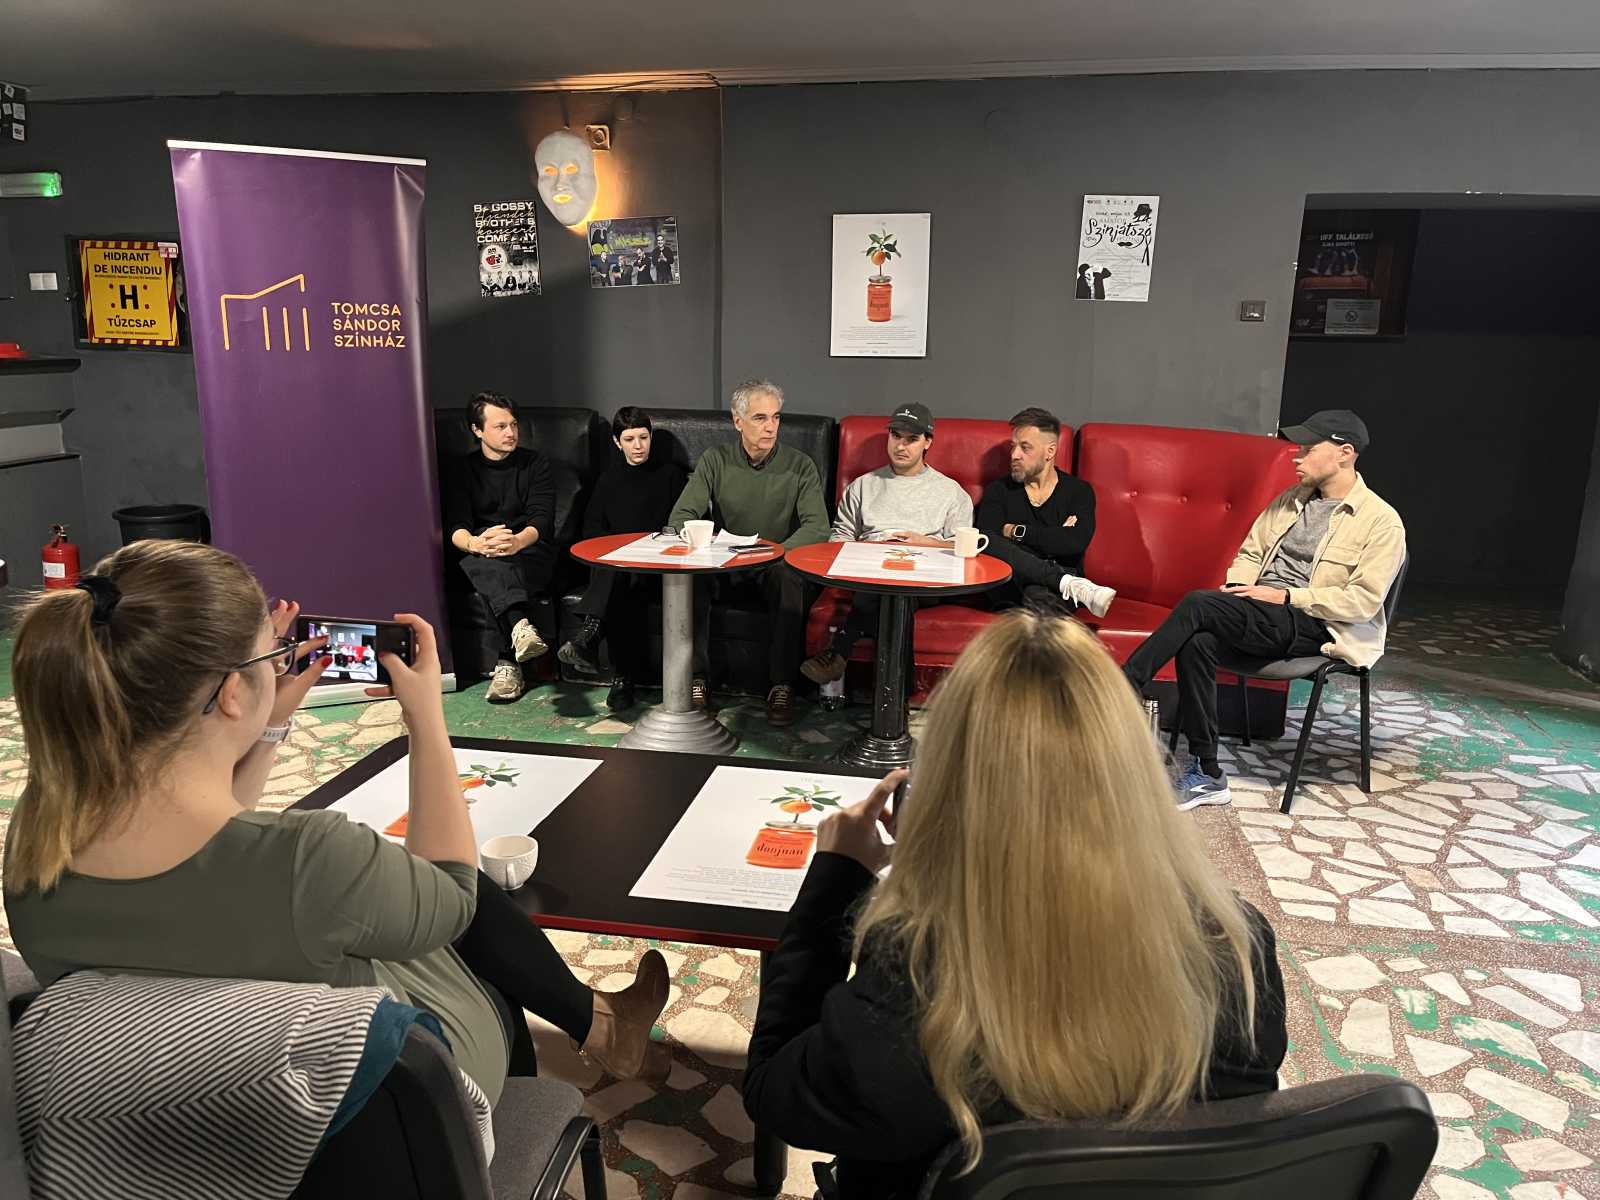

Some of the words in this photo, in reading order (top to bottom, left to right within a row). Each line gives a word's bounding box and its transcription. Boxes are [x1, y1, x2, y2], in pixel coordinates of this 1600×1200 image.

[103, 252, 150, 262] HIDRANT
[94, 264, 108, 273] DE
[111, 265, 162, 275] INCENDIU
[119, 284, 140, 310] H
[331, 302, 402, 316] TOMCSA
[333, 315, 401, 331] SÁNDOR
[334, 331, 406, 348] SZÍNHÁZ
